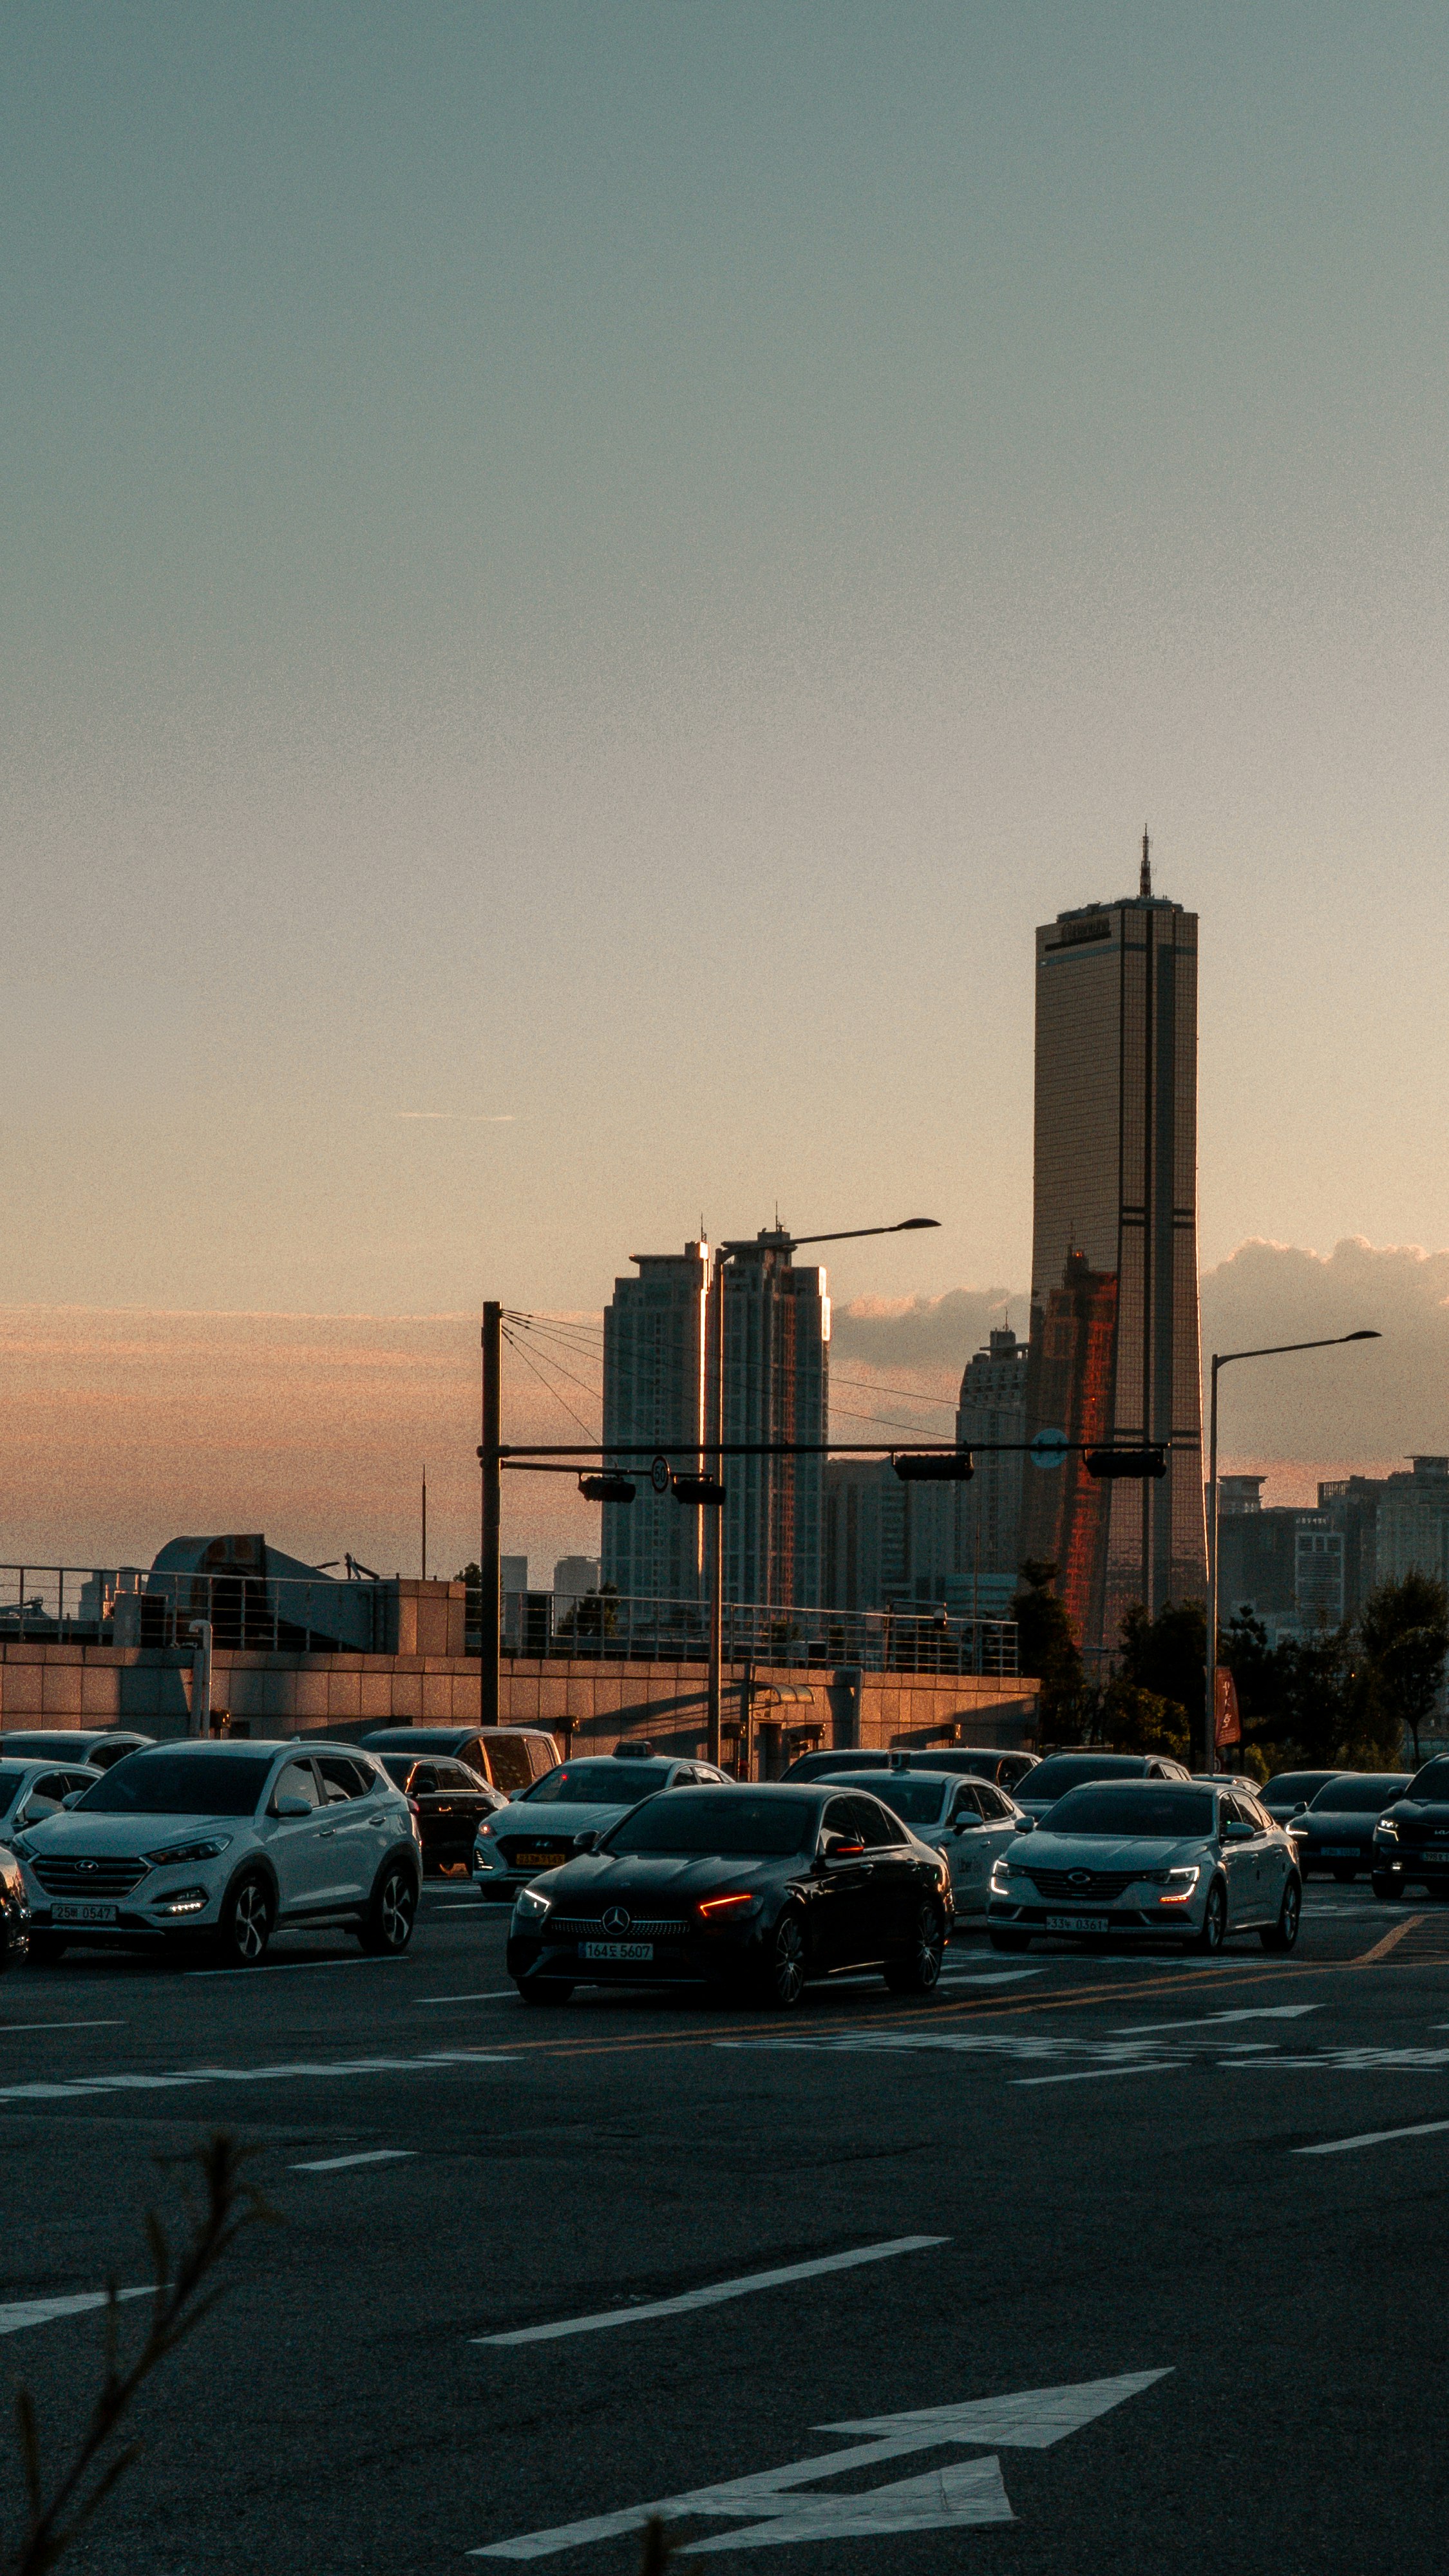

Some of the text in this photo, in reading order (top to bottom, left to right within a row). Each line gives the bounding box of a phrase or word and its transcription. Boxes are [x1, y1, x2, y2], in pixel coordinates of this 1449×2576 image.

[655, 1466, 666, 1482] 50
[82, 1907, 111, 1919] 0547
[620, 1945, 650, 1958] 5607
